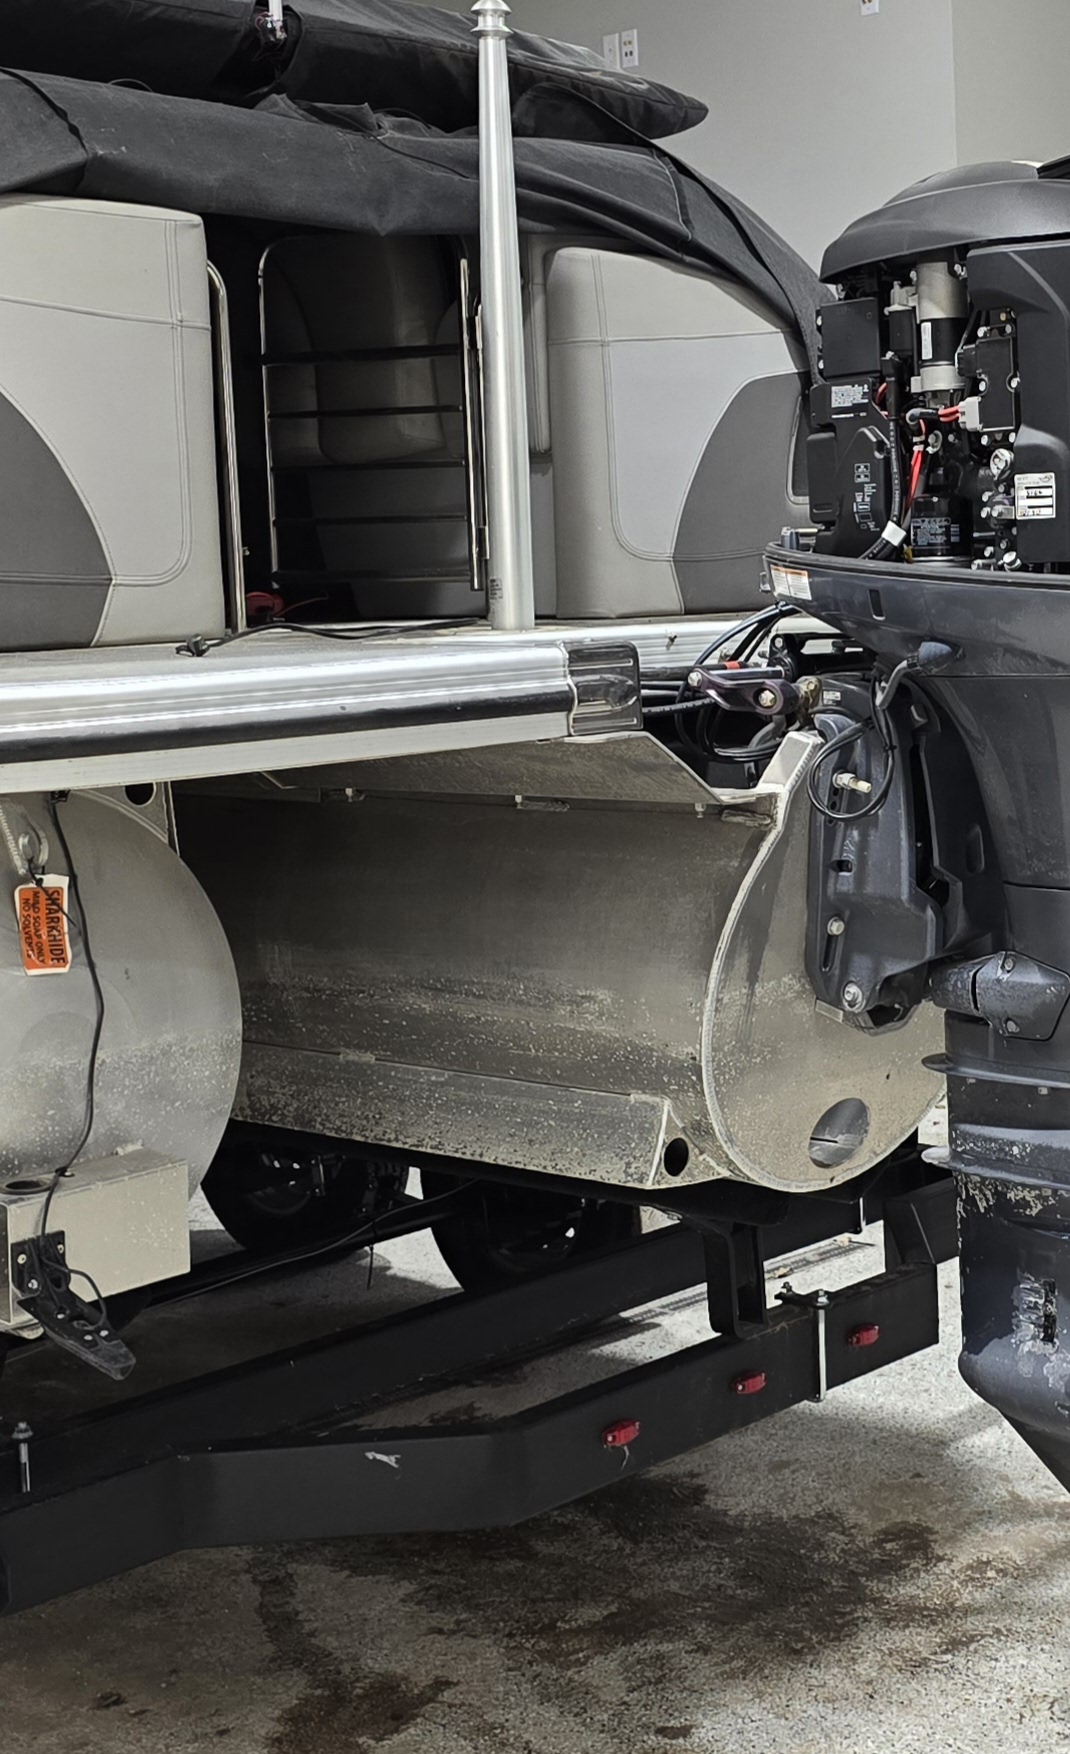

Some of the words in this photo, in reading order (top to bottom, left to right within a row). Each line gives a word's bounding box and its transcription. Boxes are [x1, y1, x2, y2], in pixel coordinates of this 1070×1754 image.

[22, 898, 31, 912] NO
[45, 889, 66, 964] SHARKHIDE
[33, 915, 42, 940] SOAP
[38, 941, 46, 965] ONLY
